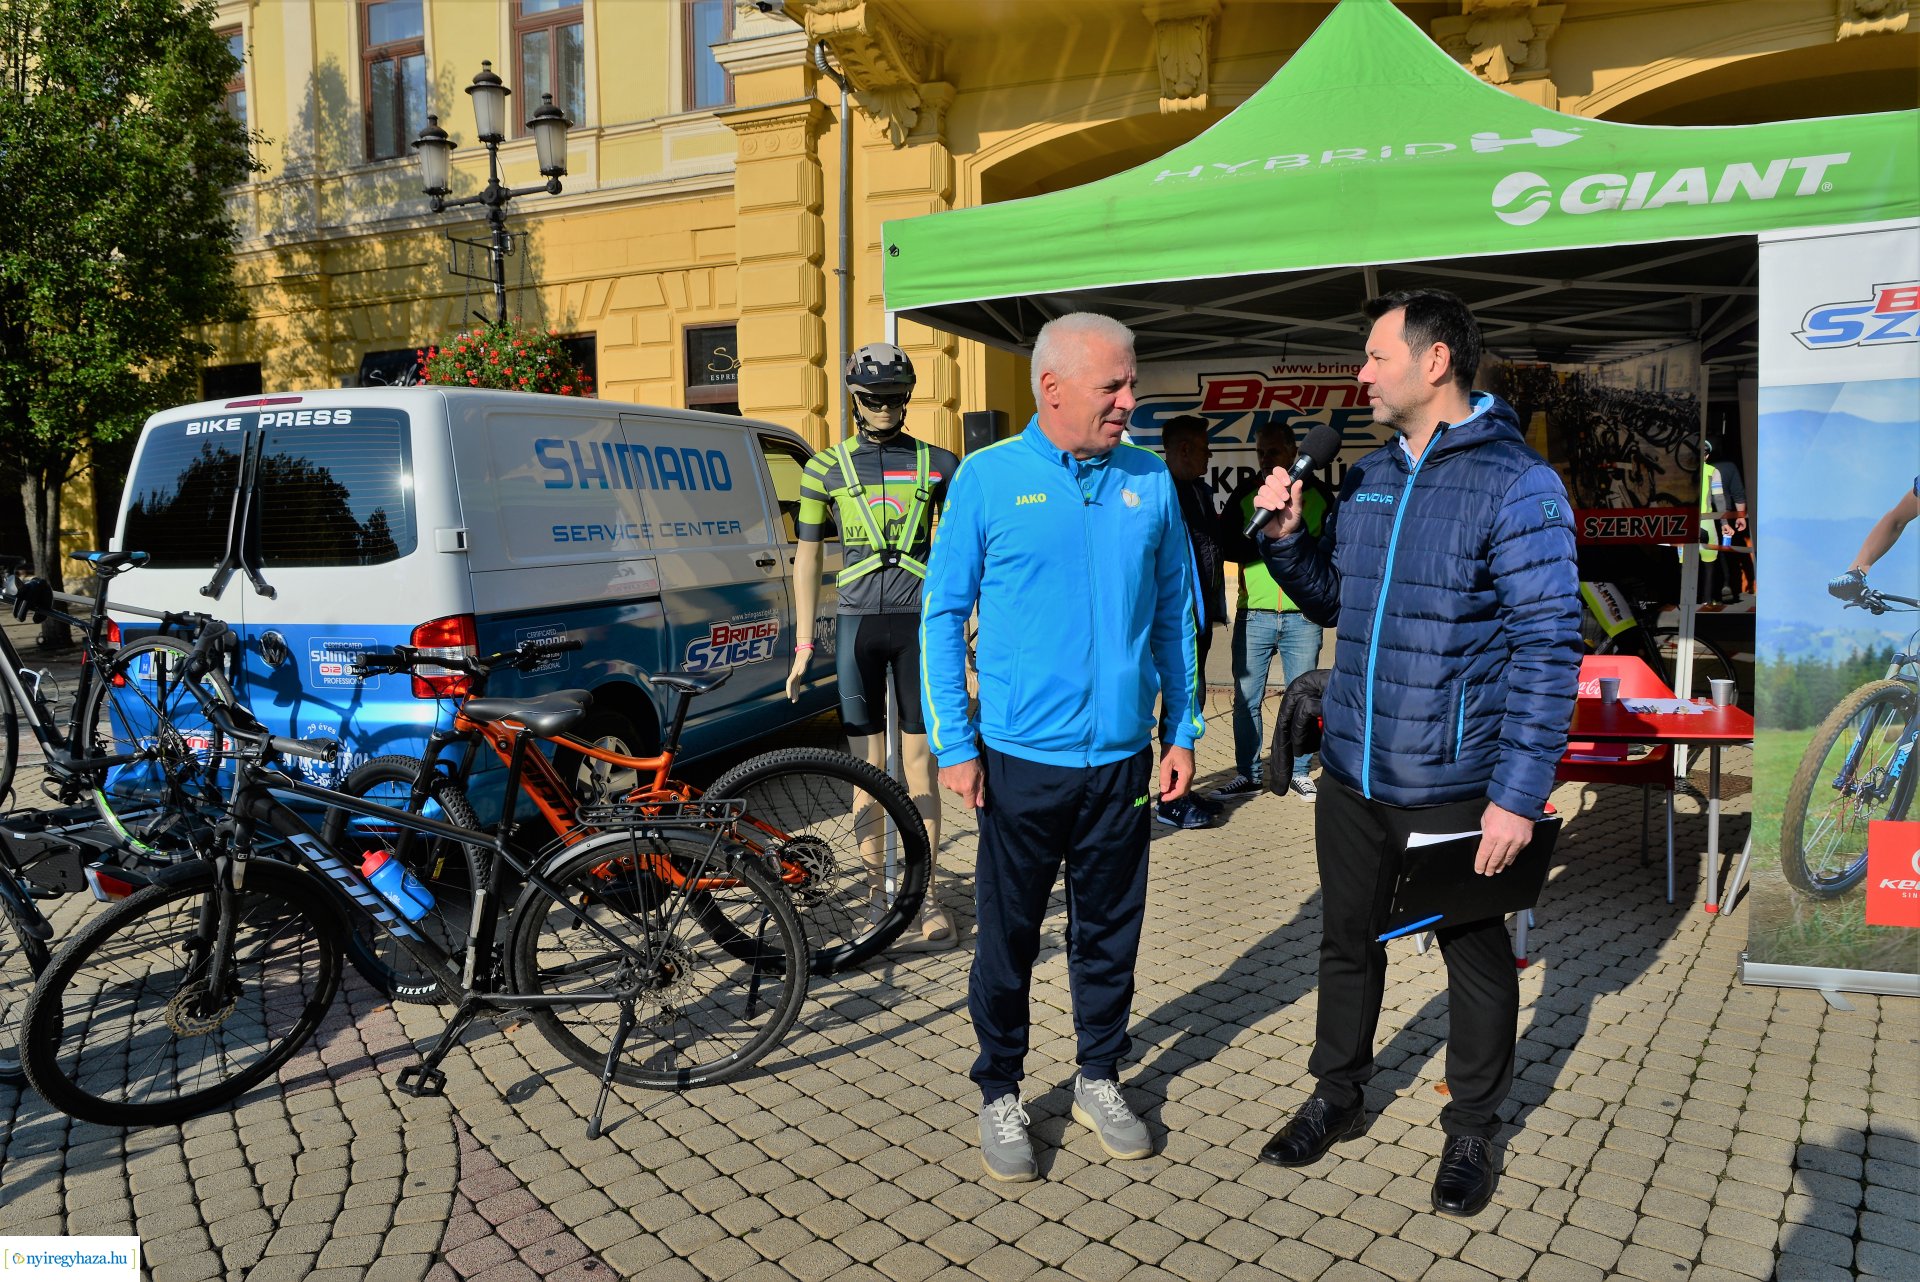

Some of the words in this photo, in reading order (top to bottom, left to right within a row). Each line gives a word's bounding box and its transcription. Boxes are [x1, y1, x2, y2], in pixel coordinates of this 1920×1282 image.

[1153, 142, 1457, 182] HYBRID
[1559, 152, 1851, 215] GIANT
[710, 373, 738, 381] ESPRE
[1272, 362, 1361, 376] www.bring
[186, 418, 242, 436] BIKE
[257, 409, 352, 429] PRESS
[534, 438, 733, 492] SHIMANO
[1015, 493, 1047, 505] JAKO
[1356, 493, 1394, 504] GIVOVA
[552, 523, 654, 542] SERVICE
[659, 520, 742, 538] CENTER
[1584, 515, 1688, 538] SZERVIZ
[711, 622, 779, 647] BRINGA
[323, 642, 363, 650] CERTIFICATED
[686, 635, 778, 672] SZIGET
[307, 723, 317, 734] 29
[318, 722, 337, 735] éves
[287, 832, 426, 944] GIANT
[396, 982, 438, 996] MAXXIS
